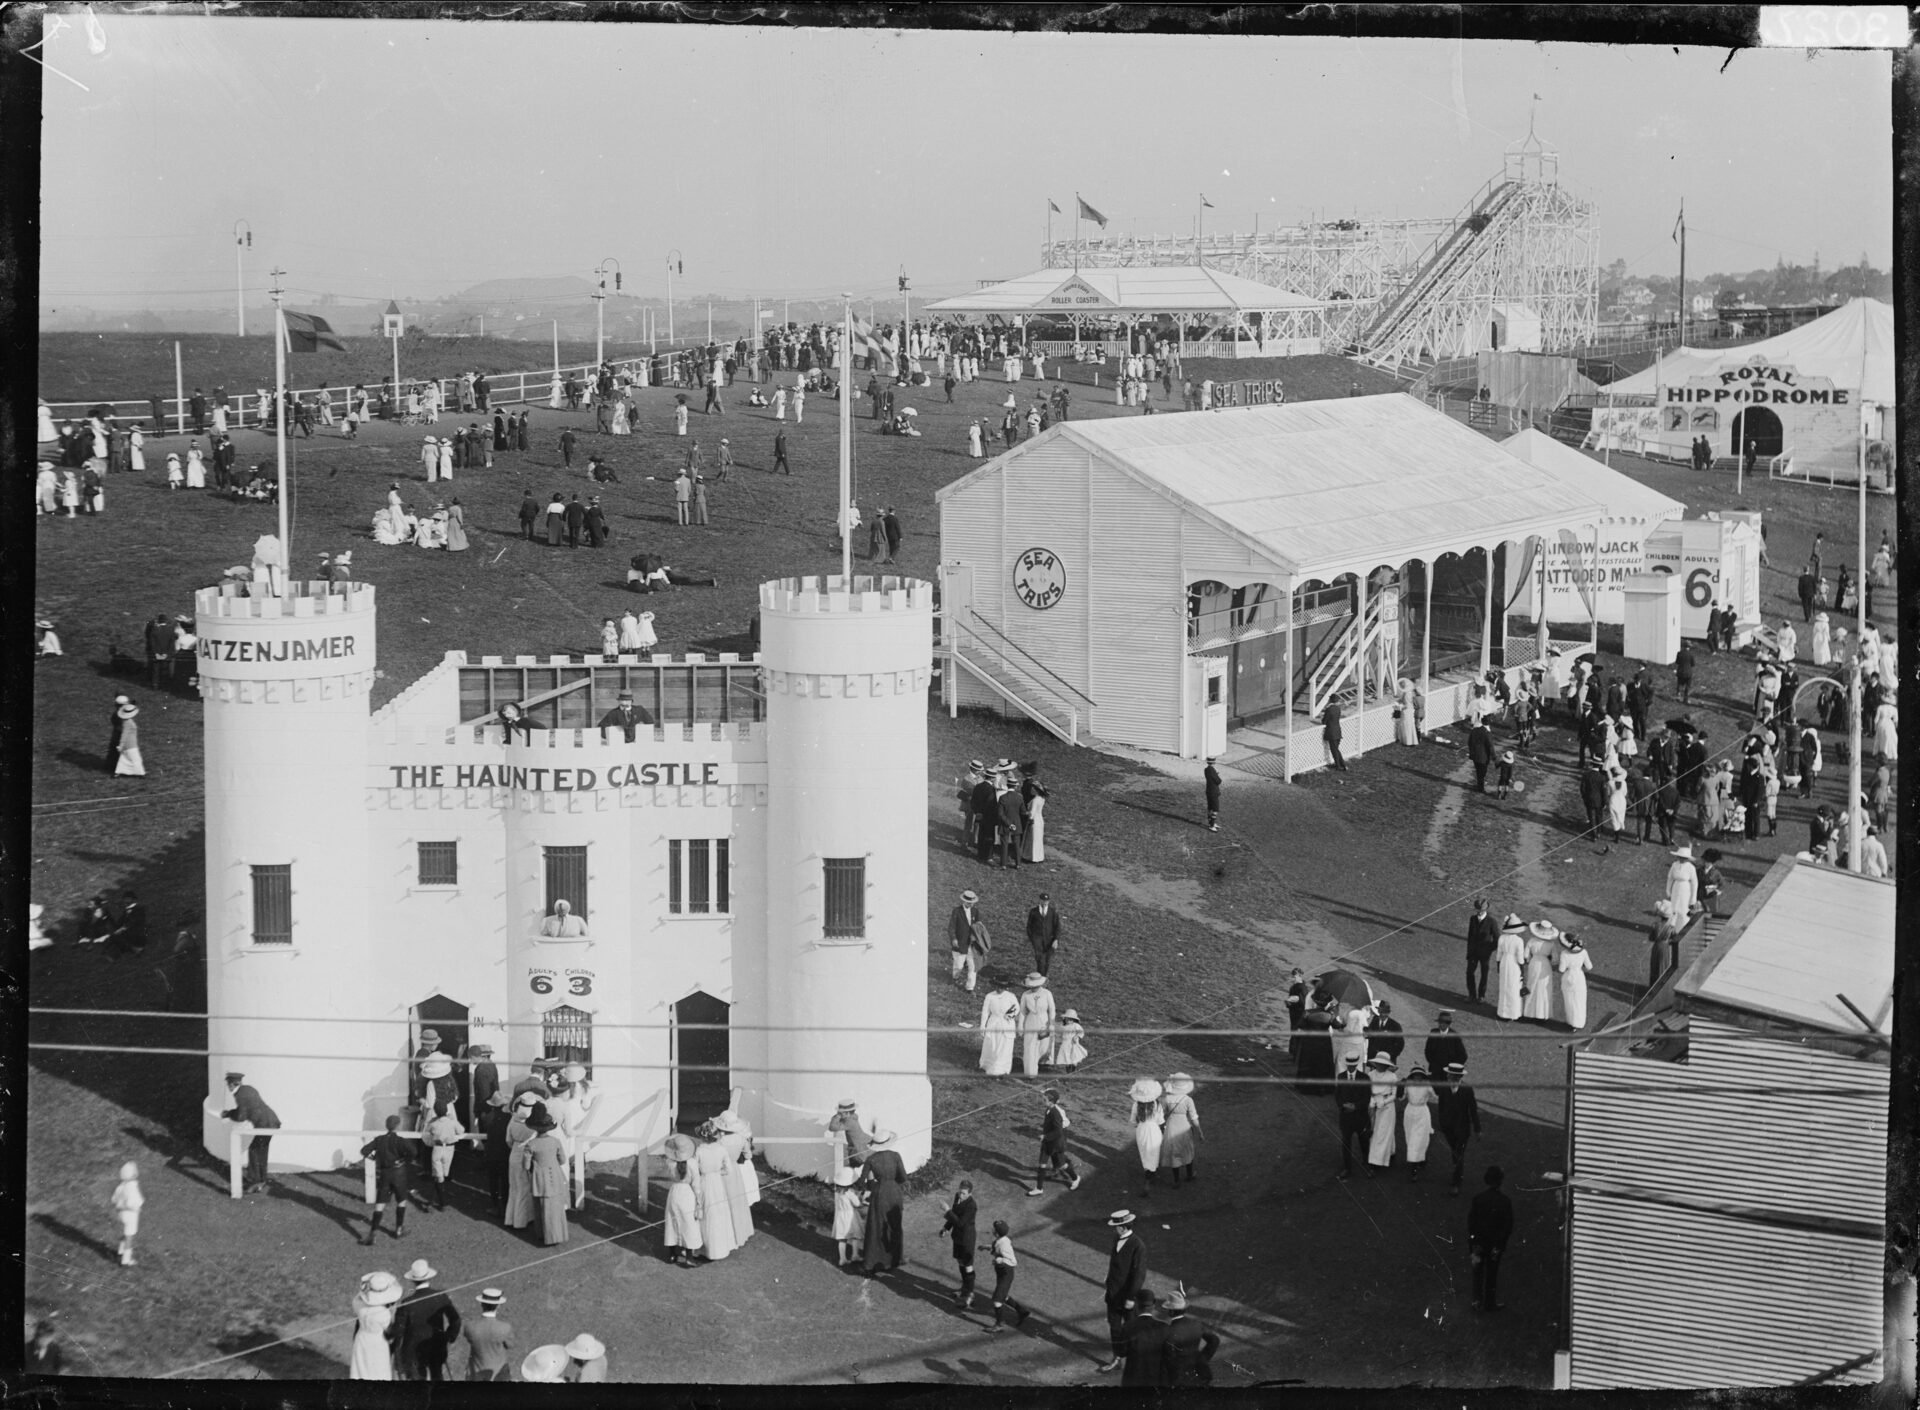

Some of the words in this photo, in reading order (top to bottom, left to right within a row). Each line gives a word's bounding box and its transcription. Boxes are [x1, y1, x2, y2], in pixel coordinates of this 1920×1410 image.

[1051, 296, 1072, 304] ROLLER
[1076, 296, 1100, 304] COASTER
[1719, 366, 1797, 387] ROYAL
[1214, 383, 1239, 407] SEA
[1667, 388, 1849, 404] HIPPODROME
[1600, 541, 1640, 553] JACK
[1645, 553, 1680, 561] CHILDREN
[1023, 551, 1055, 571] SEA
[1684, 555, 1719, 563] ADULTS
[1017, 578, 1062, 607] TRIPS
[198, 635, 355, 662] KATZENJAMER
[389, 765, 444, 788] THE
[456, 765, 597, 792] HAUNTED
[607, 763, 720, 788] CASTLE
[530, 975, 553, 995] 6
[568, 976, 593, 997] 3
